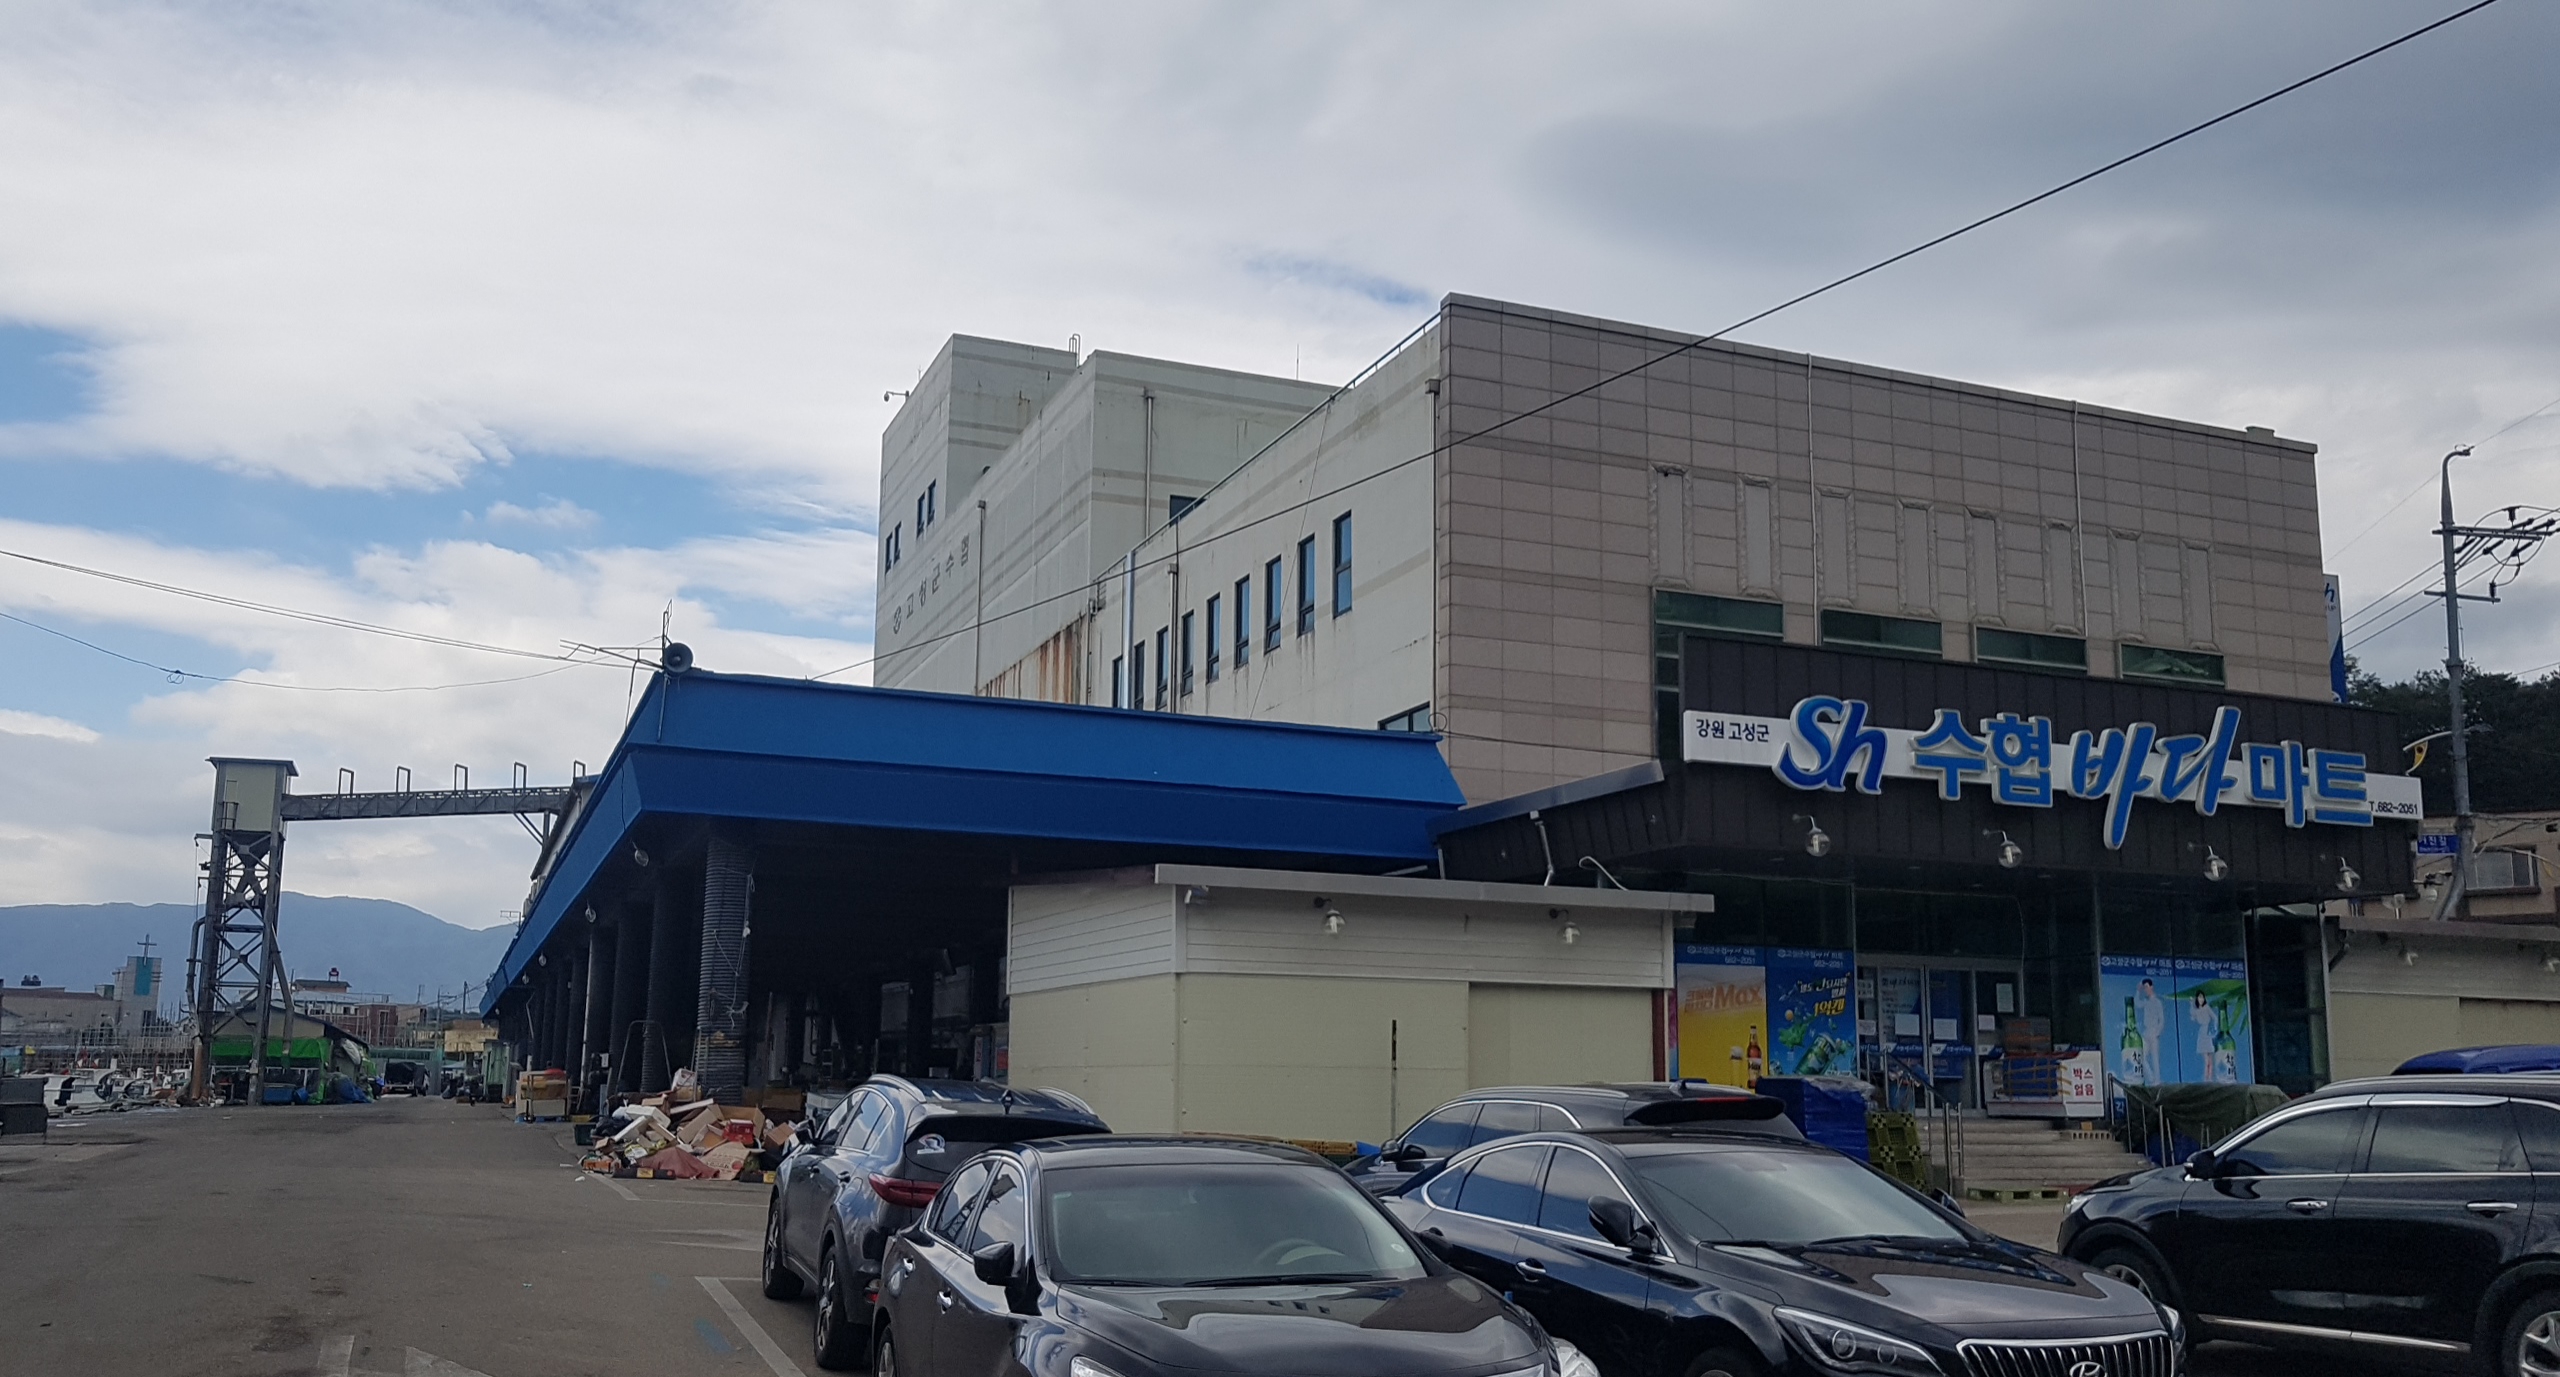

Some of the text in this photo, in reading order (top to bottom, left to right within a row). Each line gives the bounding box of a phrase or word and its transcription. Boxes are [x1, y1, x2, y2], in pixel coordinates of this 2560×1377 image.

[1696, 719, 1770, 742] 강원 고성군
[1773, 695, 1888, 795] Sh
[1908, 703, 2374, 850] 수협 바다 마트
[2369, 800, 2419, 815] T.682-2051
[1714, 982, 1762, 1009] Max
[2072, 1067, 2094, 1080] 박스
